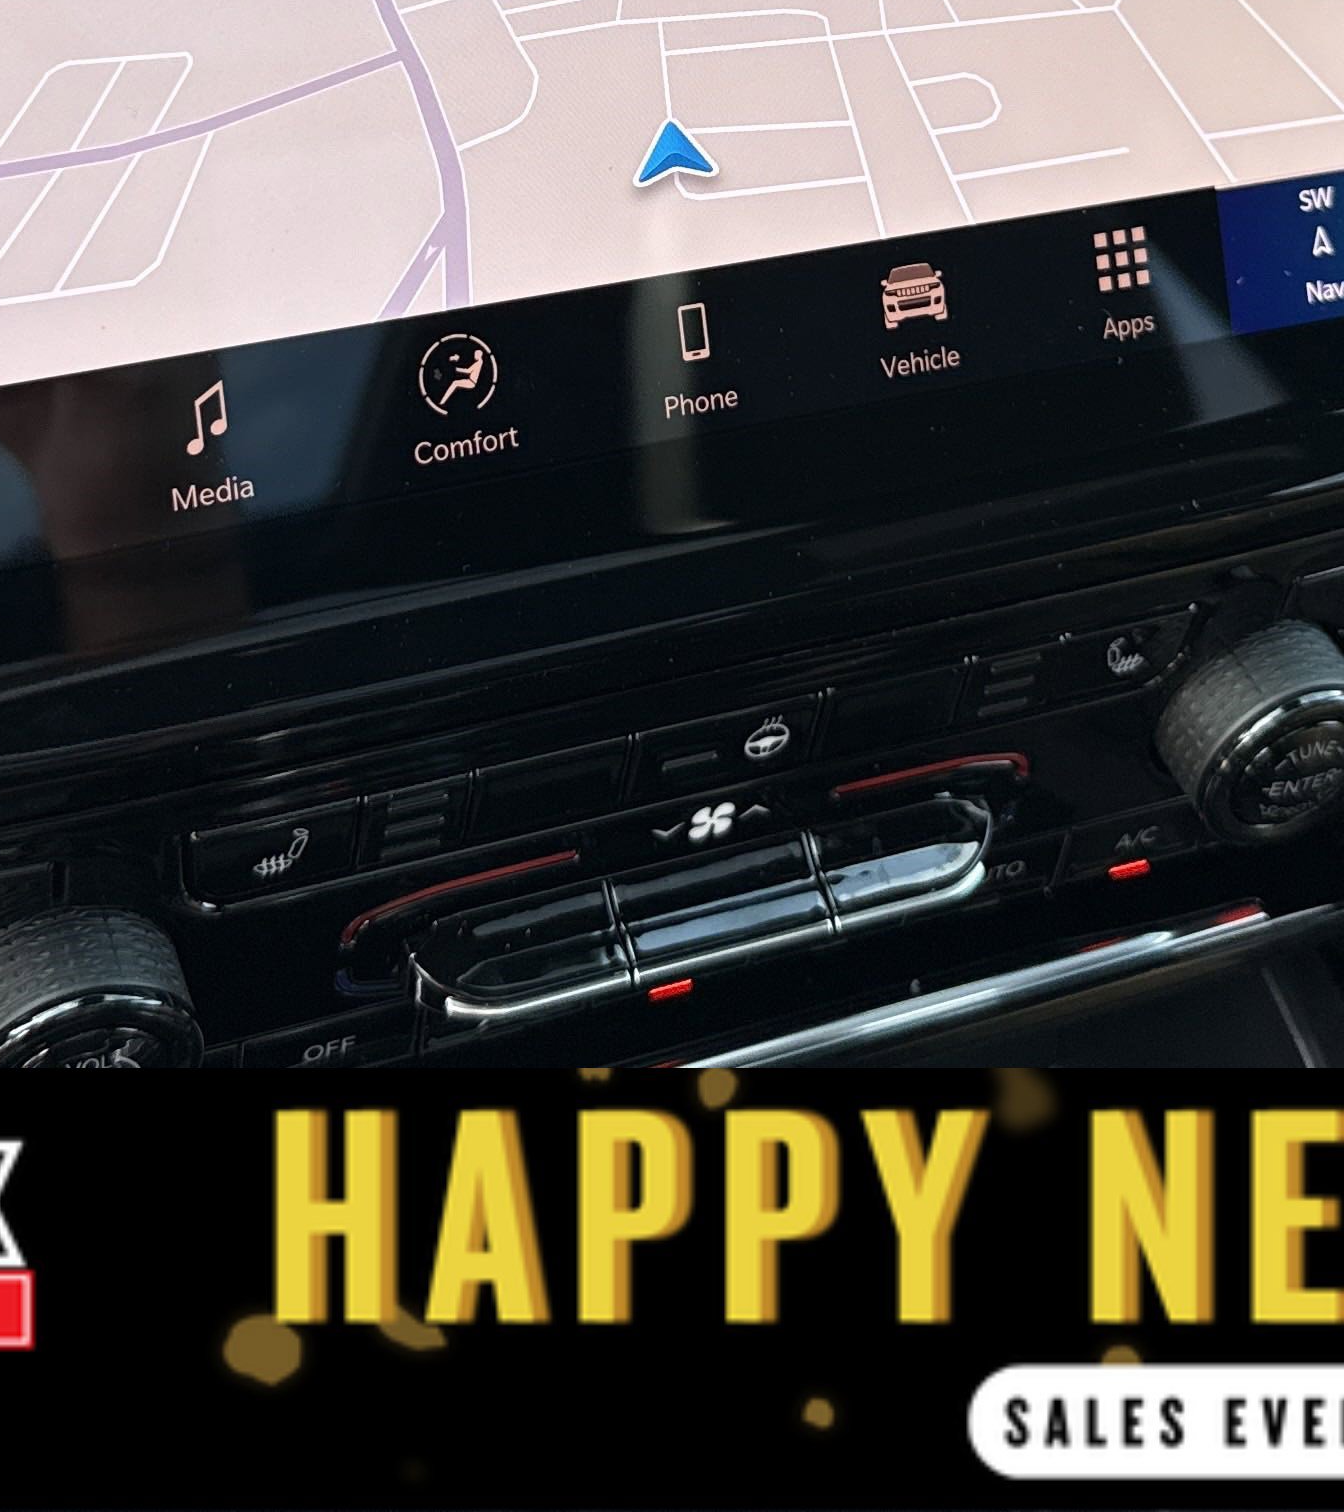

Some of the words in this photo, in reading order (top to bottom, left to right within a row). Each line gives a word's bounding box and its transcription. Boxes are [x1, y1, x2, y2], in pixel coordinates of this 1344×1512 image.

[1298, 185, 1335, 212] SW
[1102, 313, 1156, 341] Apps
[879, 345, 961, 379] Vehicle
[663, 389, 739, 420] Phone
[413, 426, 520, 466] Comfort
[171, 475, 256, 512] Media
[1286, 739, 1340, 765] TUNE
[1268, 768, 1343, 797] ENTER
[1114, 824, 1161, 851] A/C
[302, 1035, 357, 1065] OFF
